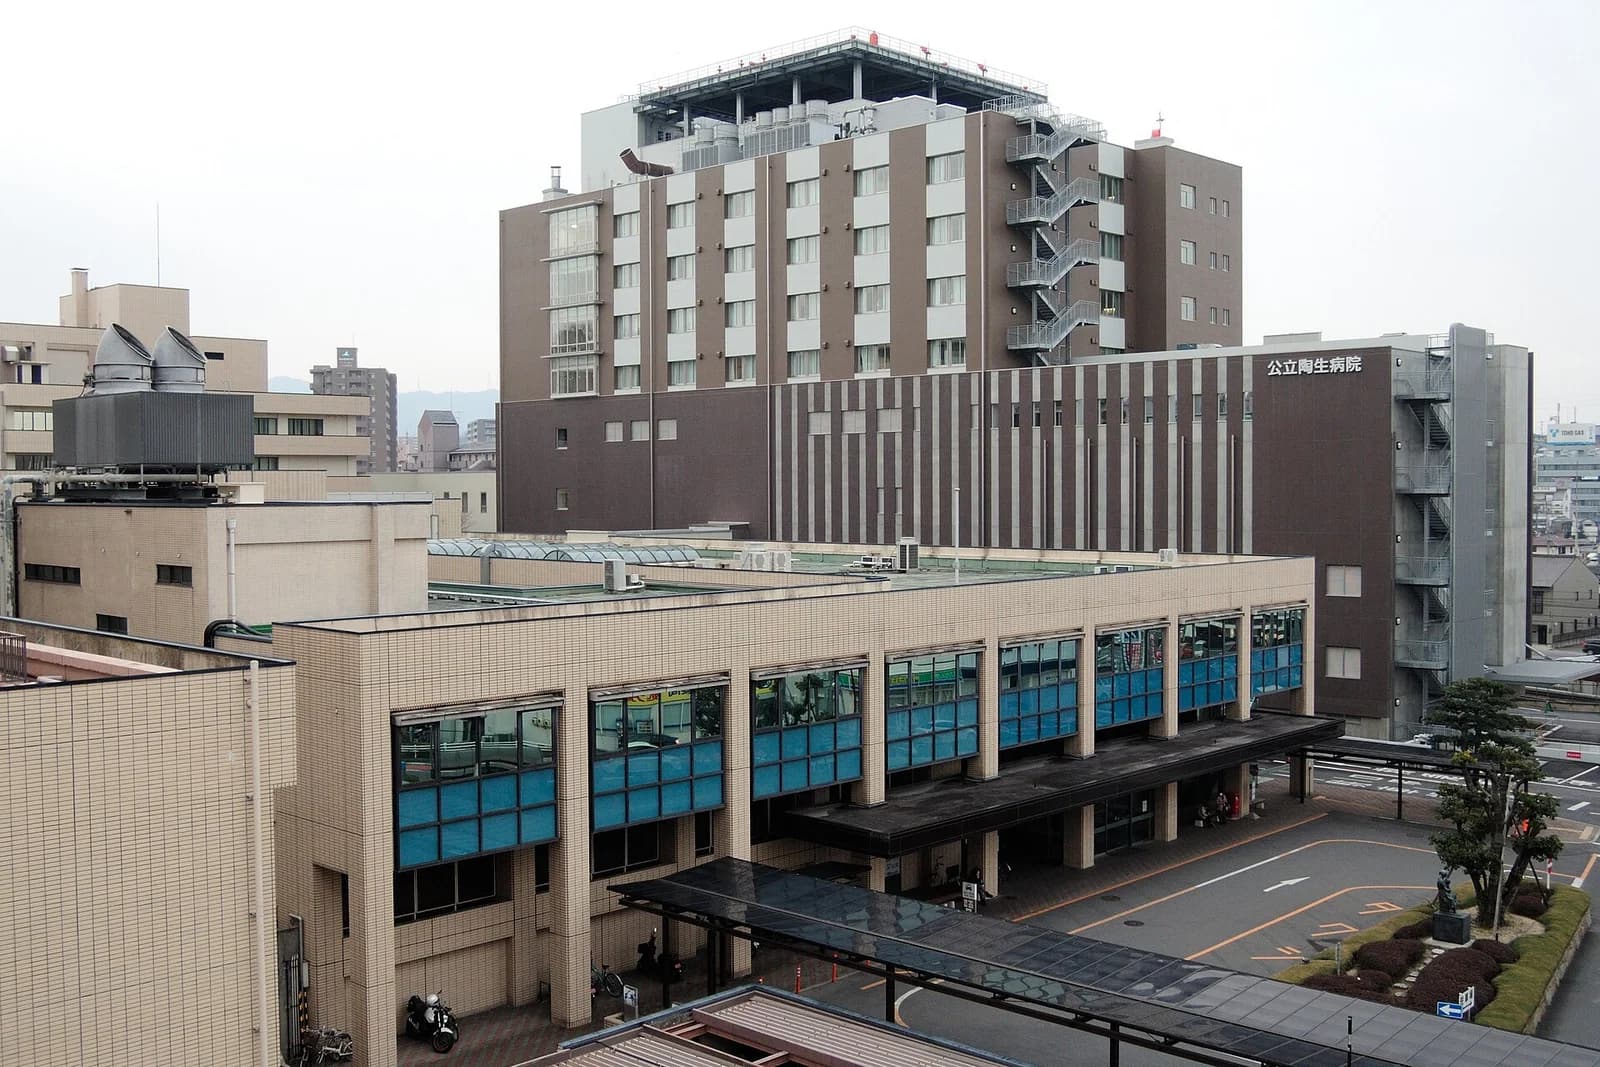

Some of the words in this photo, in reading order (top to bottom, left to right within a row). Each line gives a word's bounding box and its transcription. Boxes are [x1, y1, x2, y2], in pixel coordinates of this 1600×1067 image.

[1267, 356, 1362, 376] 公立陶生病院
